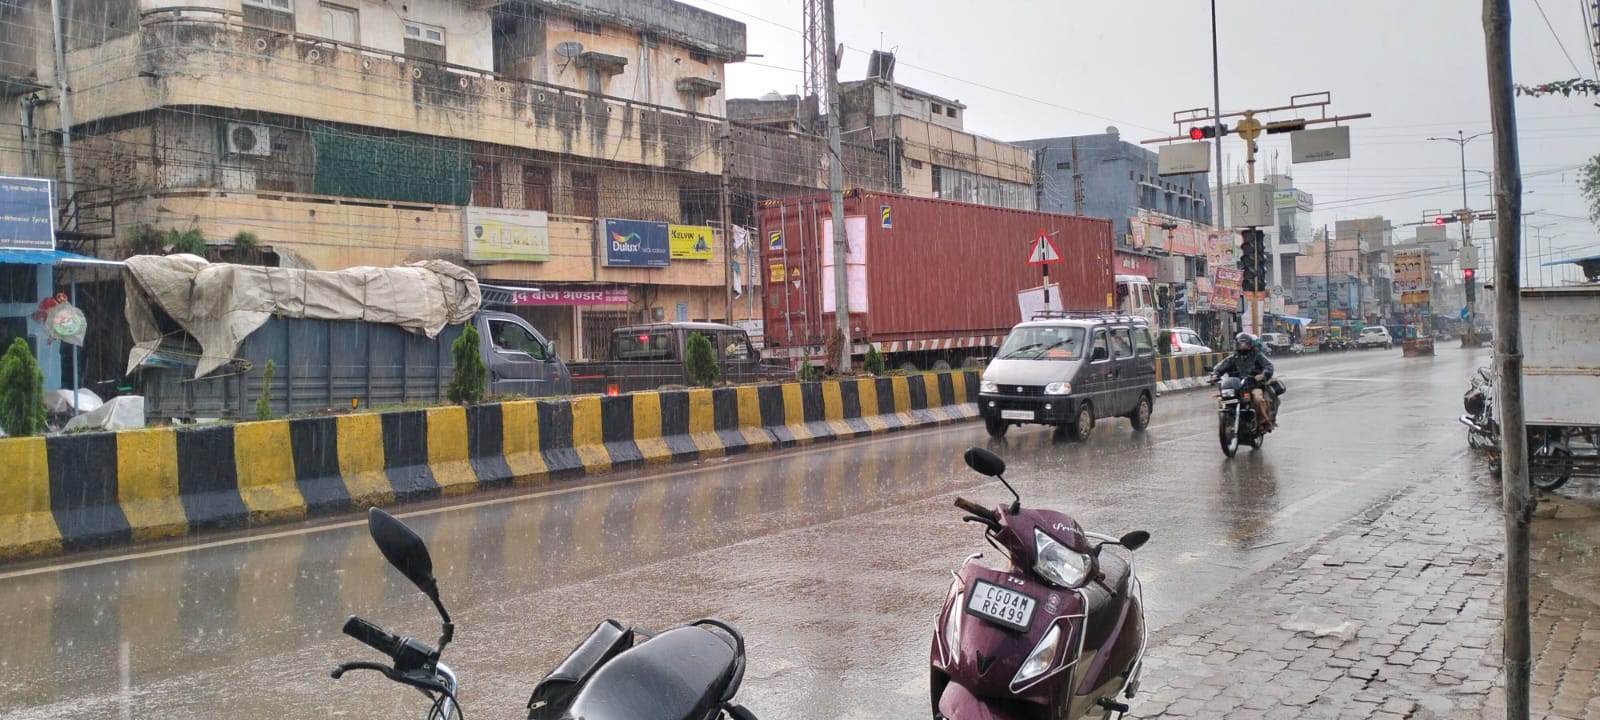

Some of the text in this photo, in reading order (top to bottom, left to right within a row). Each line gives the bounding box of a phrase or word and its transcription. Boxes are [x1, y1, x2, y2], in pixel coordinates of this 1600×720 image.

[613, 241, 639, 252] Dulux
[531, 287, 560, 300] बीज
[563, 290, 603, 300] भण्डार
[1008, 577, 1024, 585] TVS
[986, 587, 1029, 611] CG04M
[981, 600, 1024, 624] R6499
